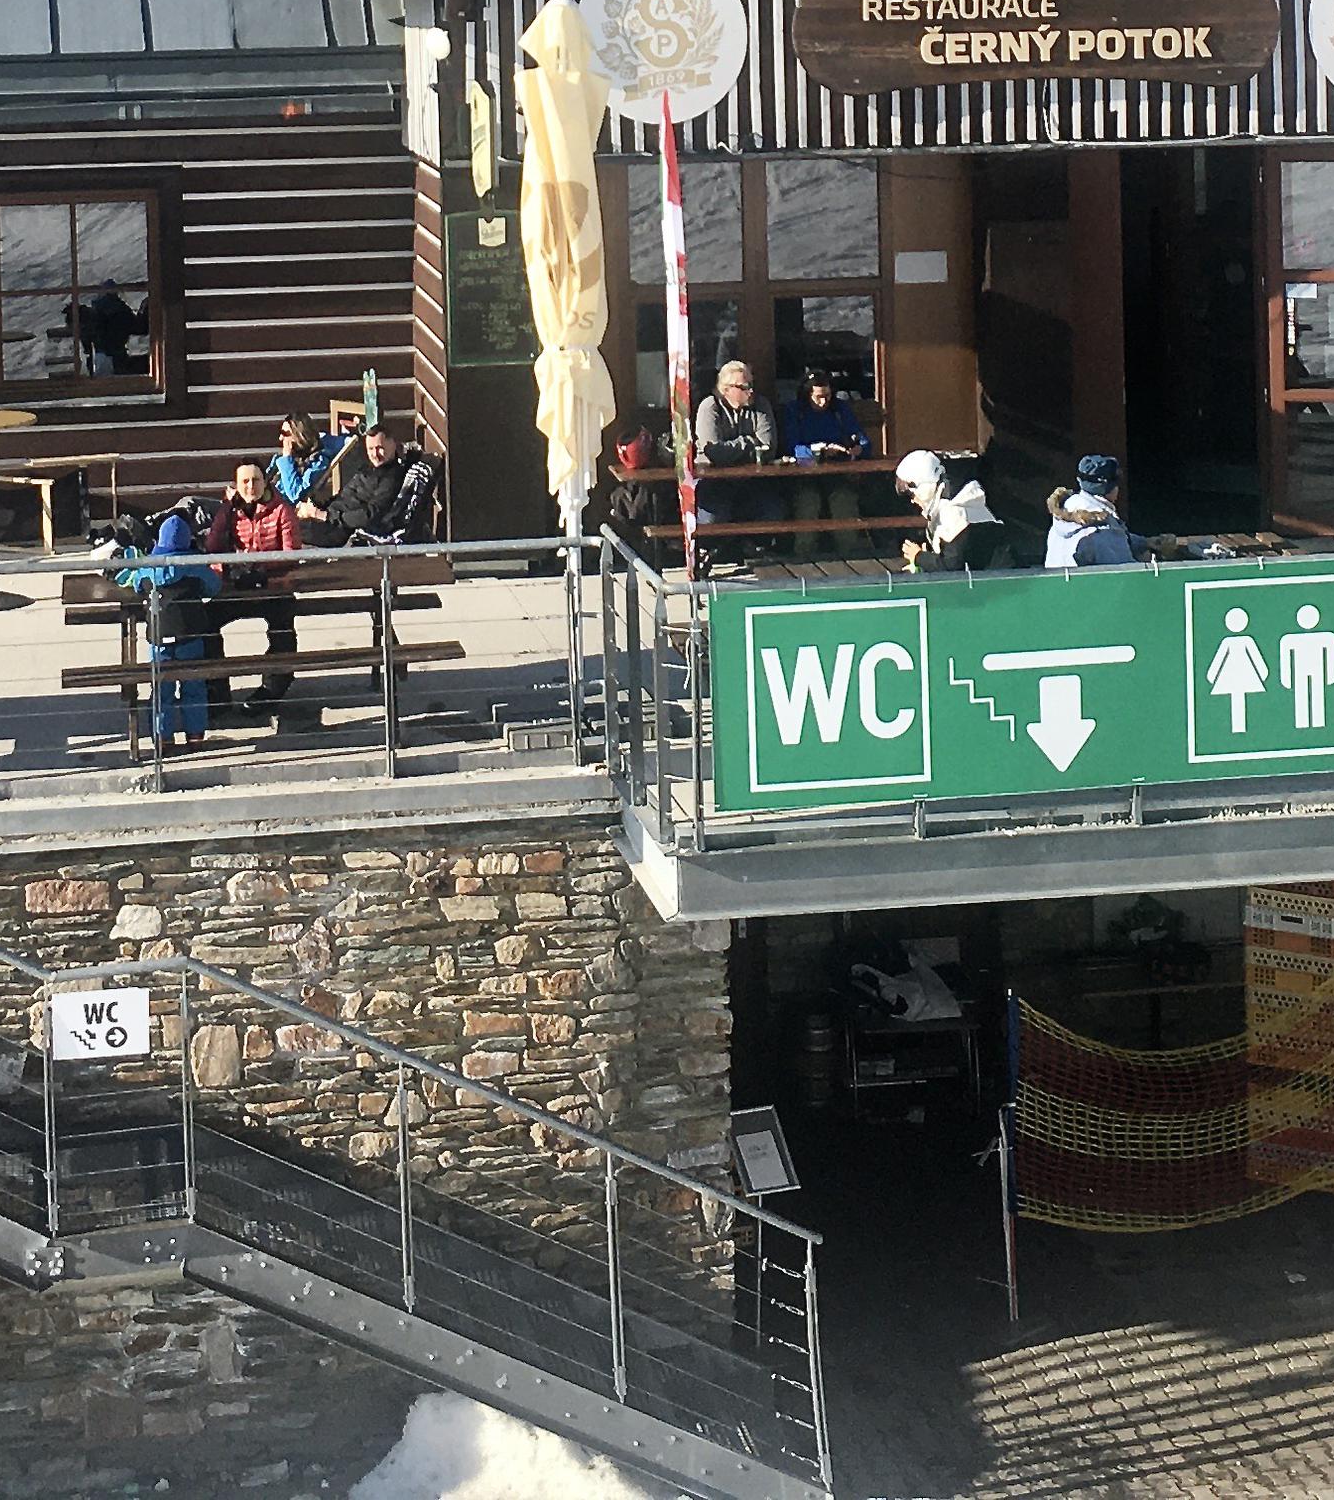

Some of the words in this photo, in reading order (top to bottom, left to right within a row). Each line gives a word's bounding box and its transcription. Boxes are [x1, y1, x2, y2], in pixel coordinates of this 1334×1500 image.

[920, 23, 1061, 64] ČERNÝ
[1068, 27, 1212, 61] POTOK
[648, 71, 686, 86] 1869
[760, 641, 915, 745] WC
[83, 1001, 119, 1025] WC
